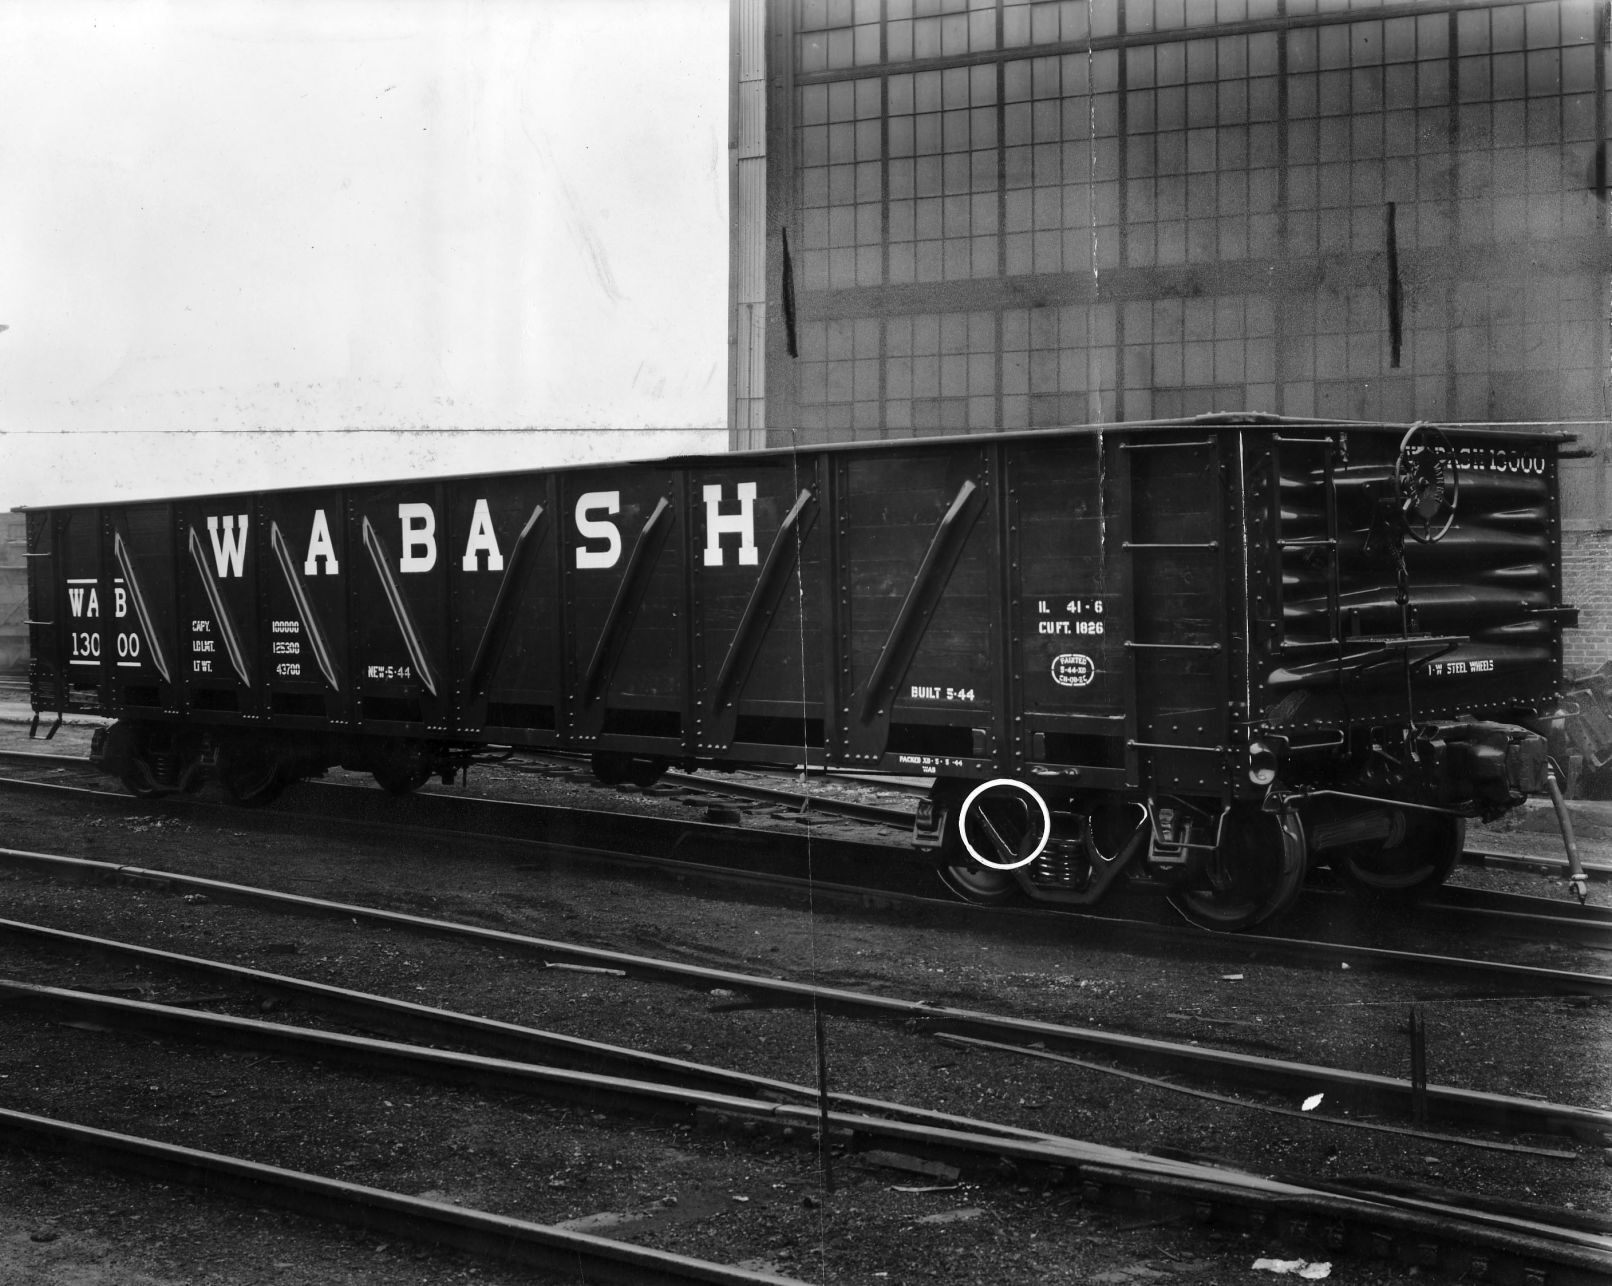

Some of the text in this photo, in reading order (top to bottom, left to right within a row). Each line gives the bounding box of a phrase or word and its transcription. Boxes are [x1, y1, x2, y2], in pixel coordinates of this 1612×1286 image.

[207, 482, 758, 578] WABASH
[68, 587, 127, 618] WAB
[272, 620, 299, 633] 100000
[1076, 621, 1104, 635] 1826
[72, 632, 139, 657] 13000
[273, 641, 300, 654] 125300
[276, 663, 301, 676] 43700
[1447, 662, 1468, 675] STEEL
[1469, 660, 1494, 673] WHEELS
[911, 686, 941, 699] BUILT
[899, 755, 921, 764] PACKED
